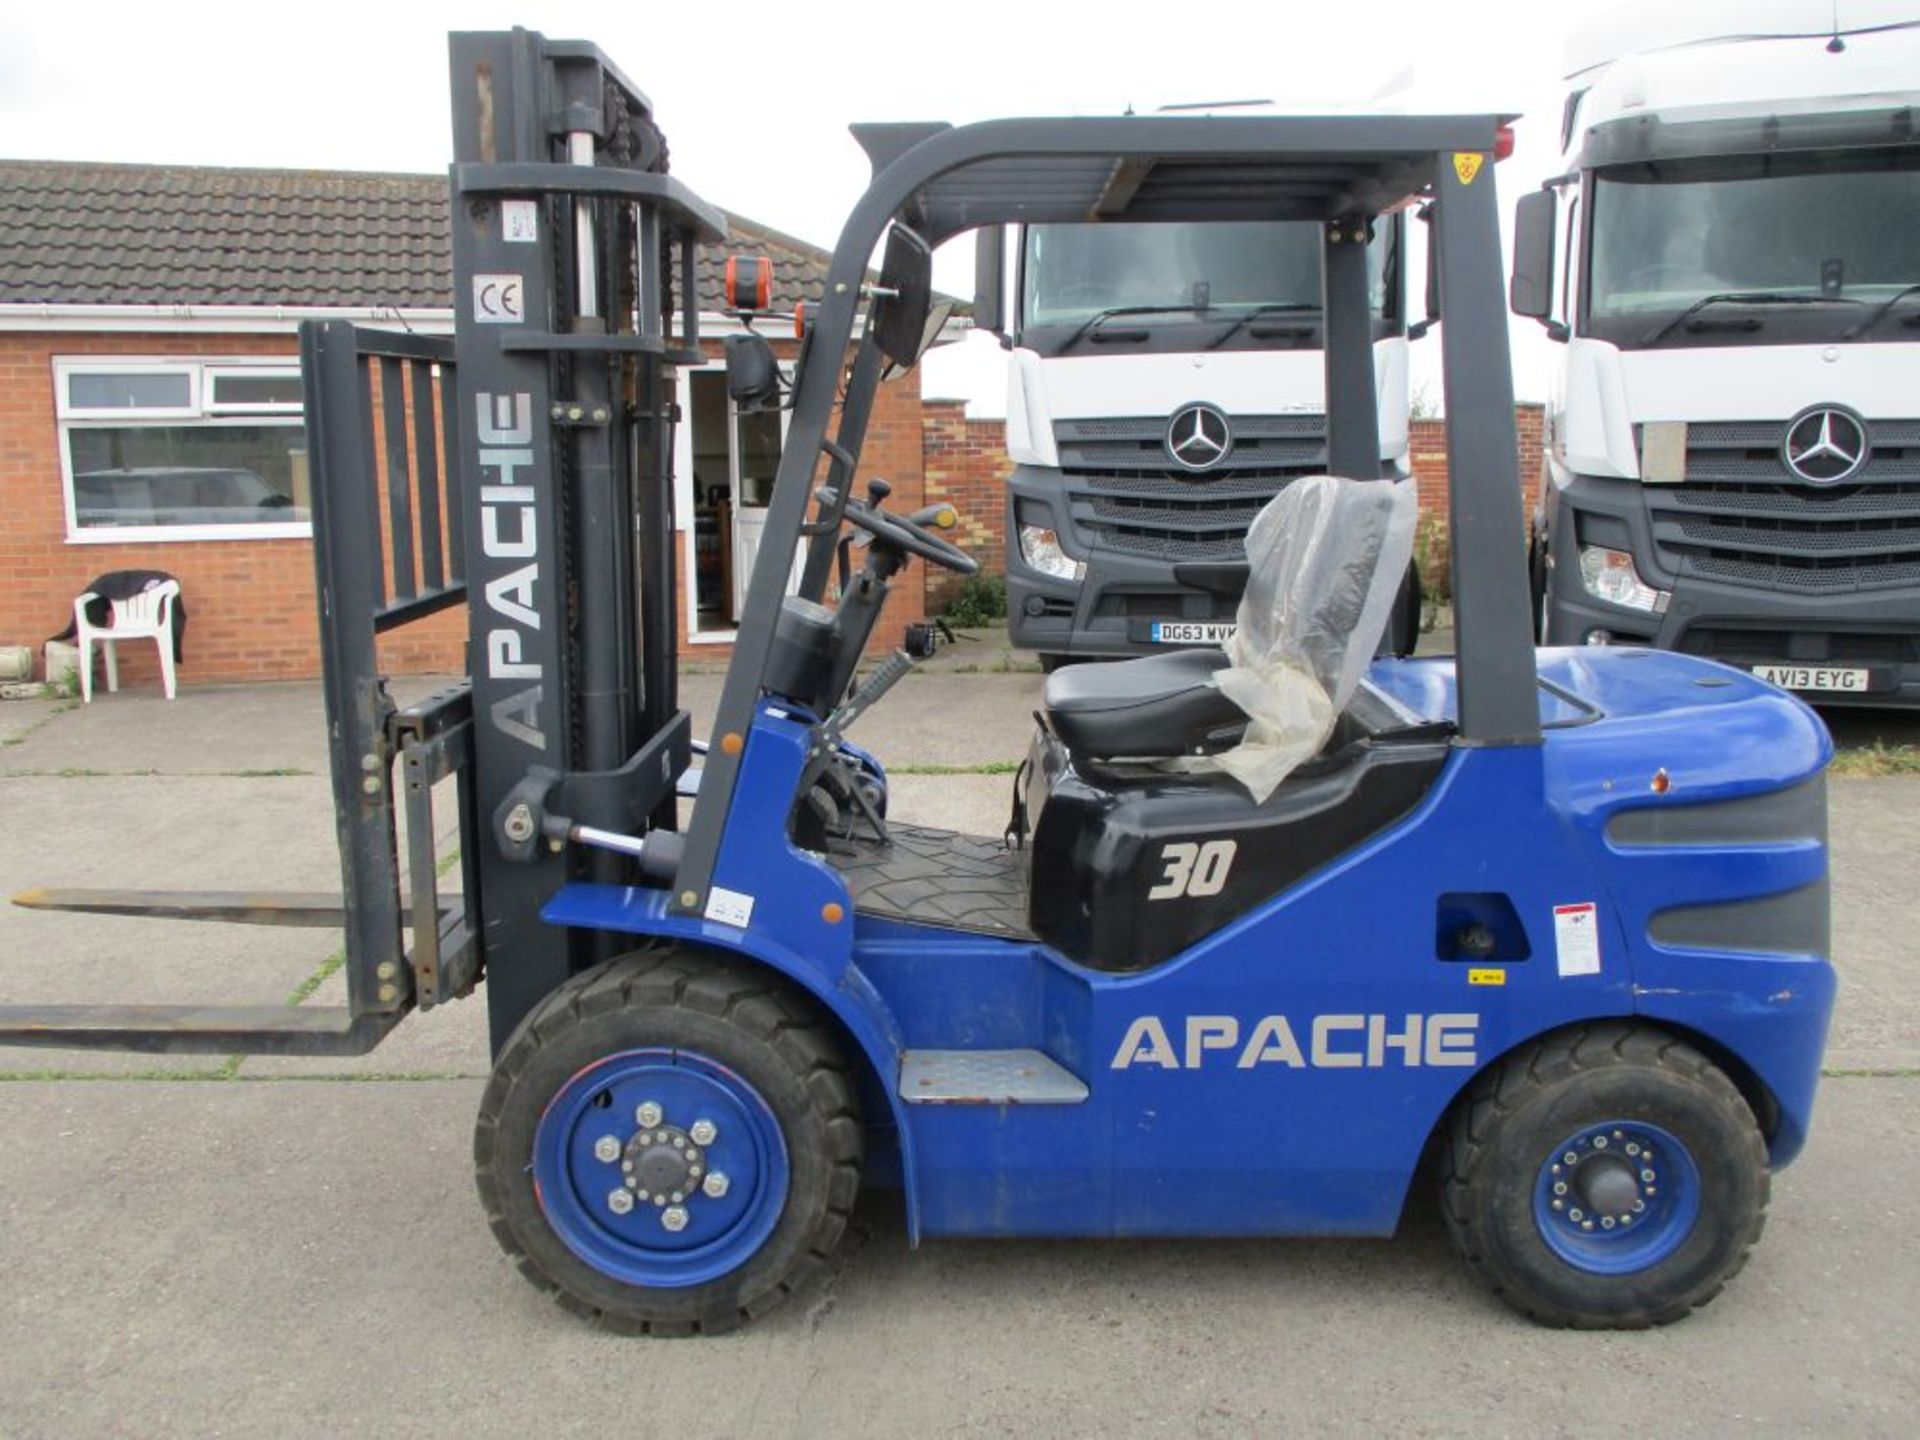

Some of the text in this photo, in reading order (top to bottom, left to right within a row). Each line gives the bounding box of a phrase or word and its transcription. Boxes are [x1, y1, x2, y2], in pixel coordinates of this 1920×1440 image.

[481, 283, 518, 316] CE
[475, 392, 546, 750] APACHE
[1163, 625, 1202, 640] DG63
[1766, 669, 1855, 688] AV13 EYG
[1148, 840, 1237, 900] 30
[1110, 1013, 1479, 1068] APACHE
